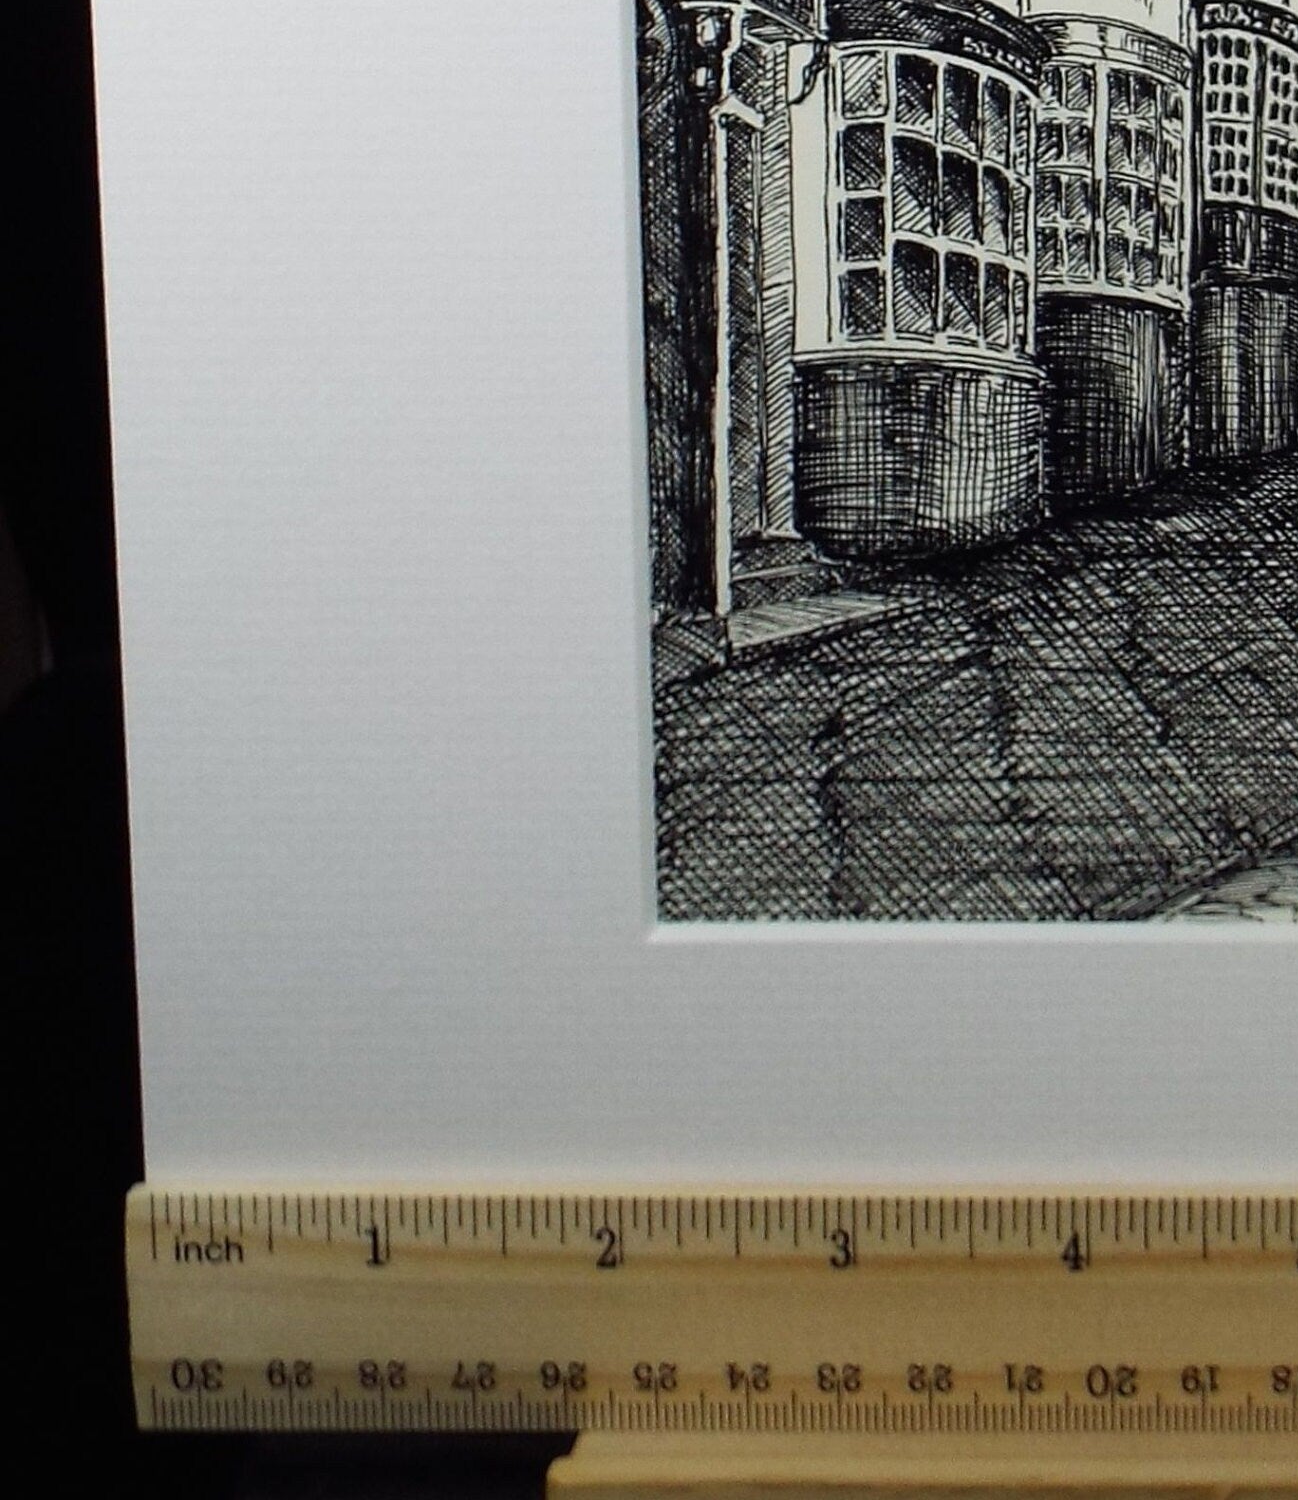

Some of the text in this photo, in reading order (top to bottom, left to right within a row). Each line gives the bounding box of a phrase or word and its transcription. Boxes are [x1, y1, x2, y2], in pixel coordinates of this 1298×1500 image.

[172, 1234, 245, 1264] inch
[363, 1228, 384, 1267] 1
[594, 1228, 619, 1268] 2
[828, 1229, 852, 1268] 3
[1060, 1231, 1084, 1271] 4
[171, 1358, 224, 1393] 30
[267, 1360, 314, 1390] 29
[358, 1361, 406, 1391] 28
[451, 1361, 496, 1391] 27
[540, 1361, 587, 1391] 26
[633, 1361, 678, 1392] 25
[726, 1361, 771, 1392] 24
[817, 1362, 863, 1392] 23
[907, 1364, 954, 1393] 22
[1004, 1364, 1043, 1393] 21
[1086, 1364, 1139, 1398] 20
[1181, 1364, 1220, 1393] 19
